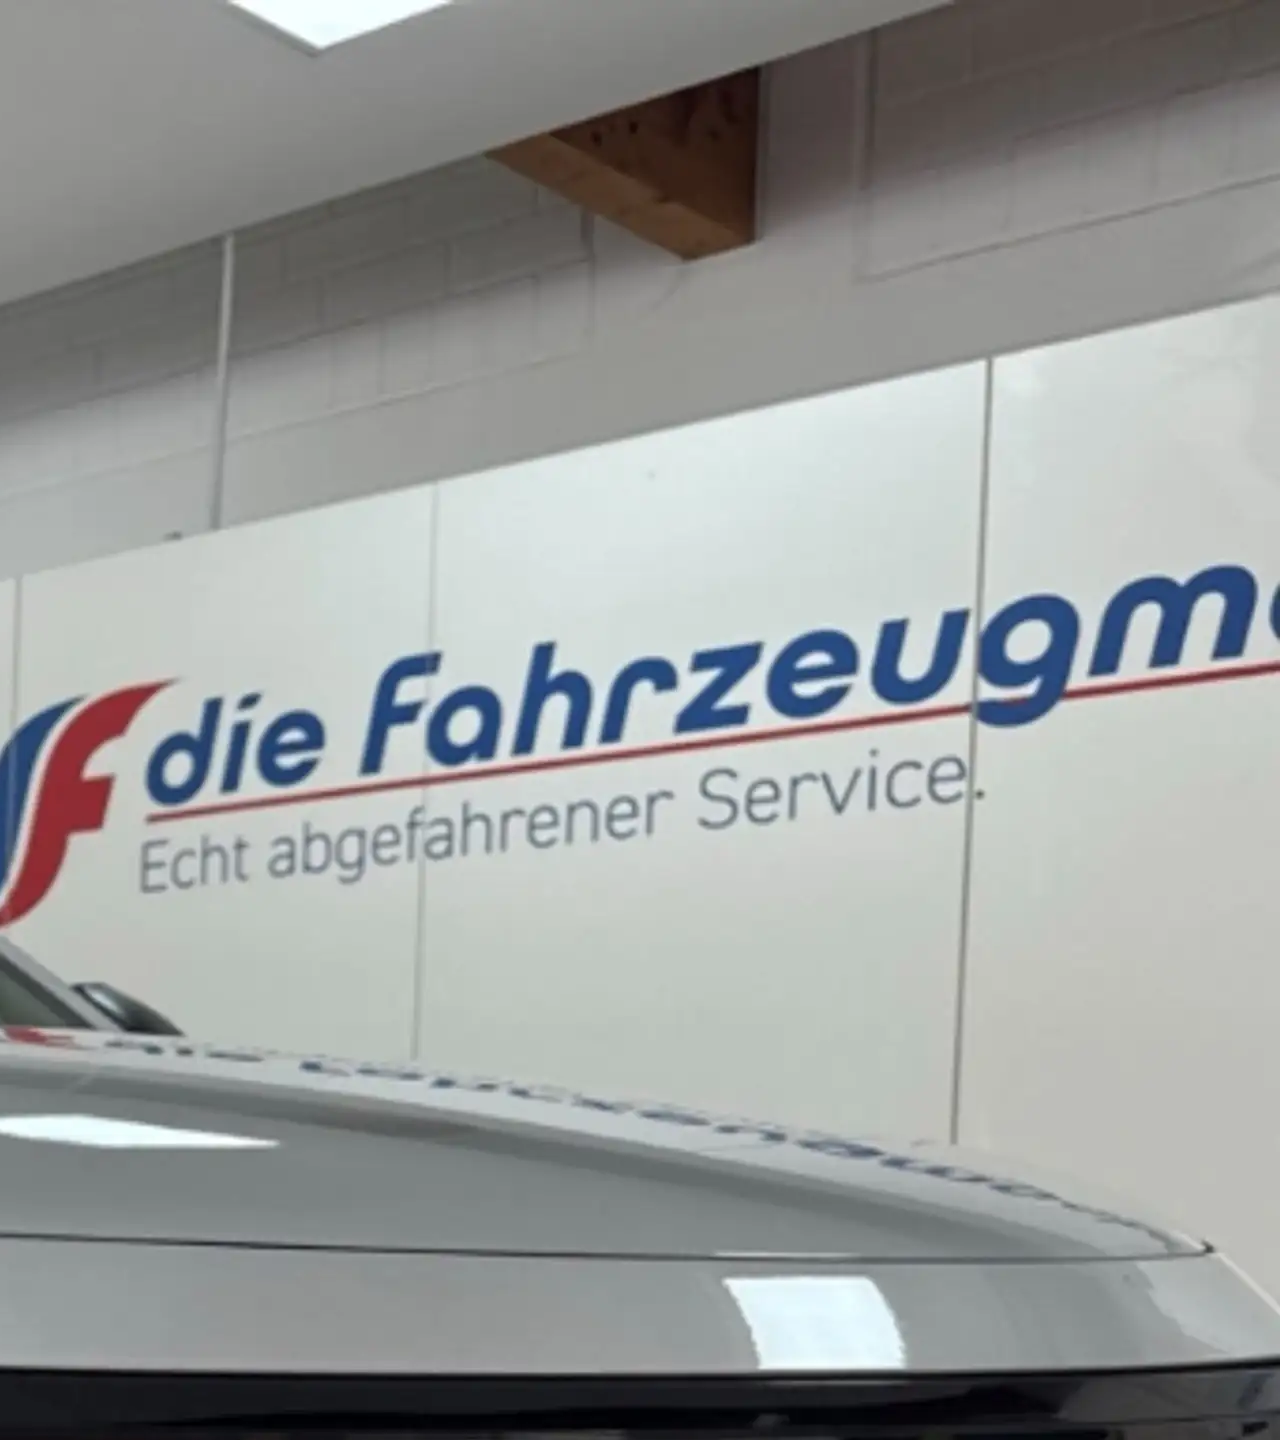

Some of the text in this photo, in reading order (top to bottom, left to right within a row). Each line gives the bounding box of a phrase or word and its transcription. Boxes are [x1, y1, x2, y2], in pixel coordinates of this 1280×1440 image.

[144, 563, 1280, 806] die Fahrzeugm
[138, 748, 986, 894] Echt abgefahrener Service.
